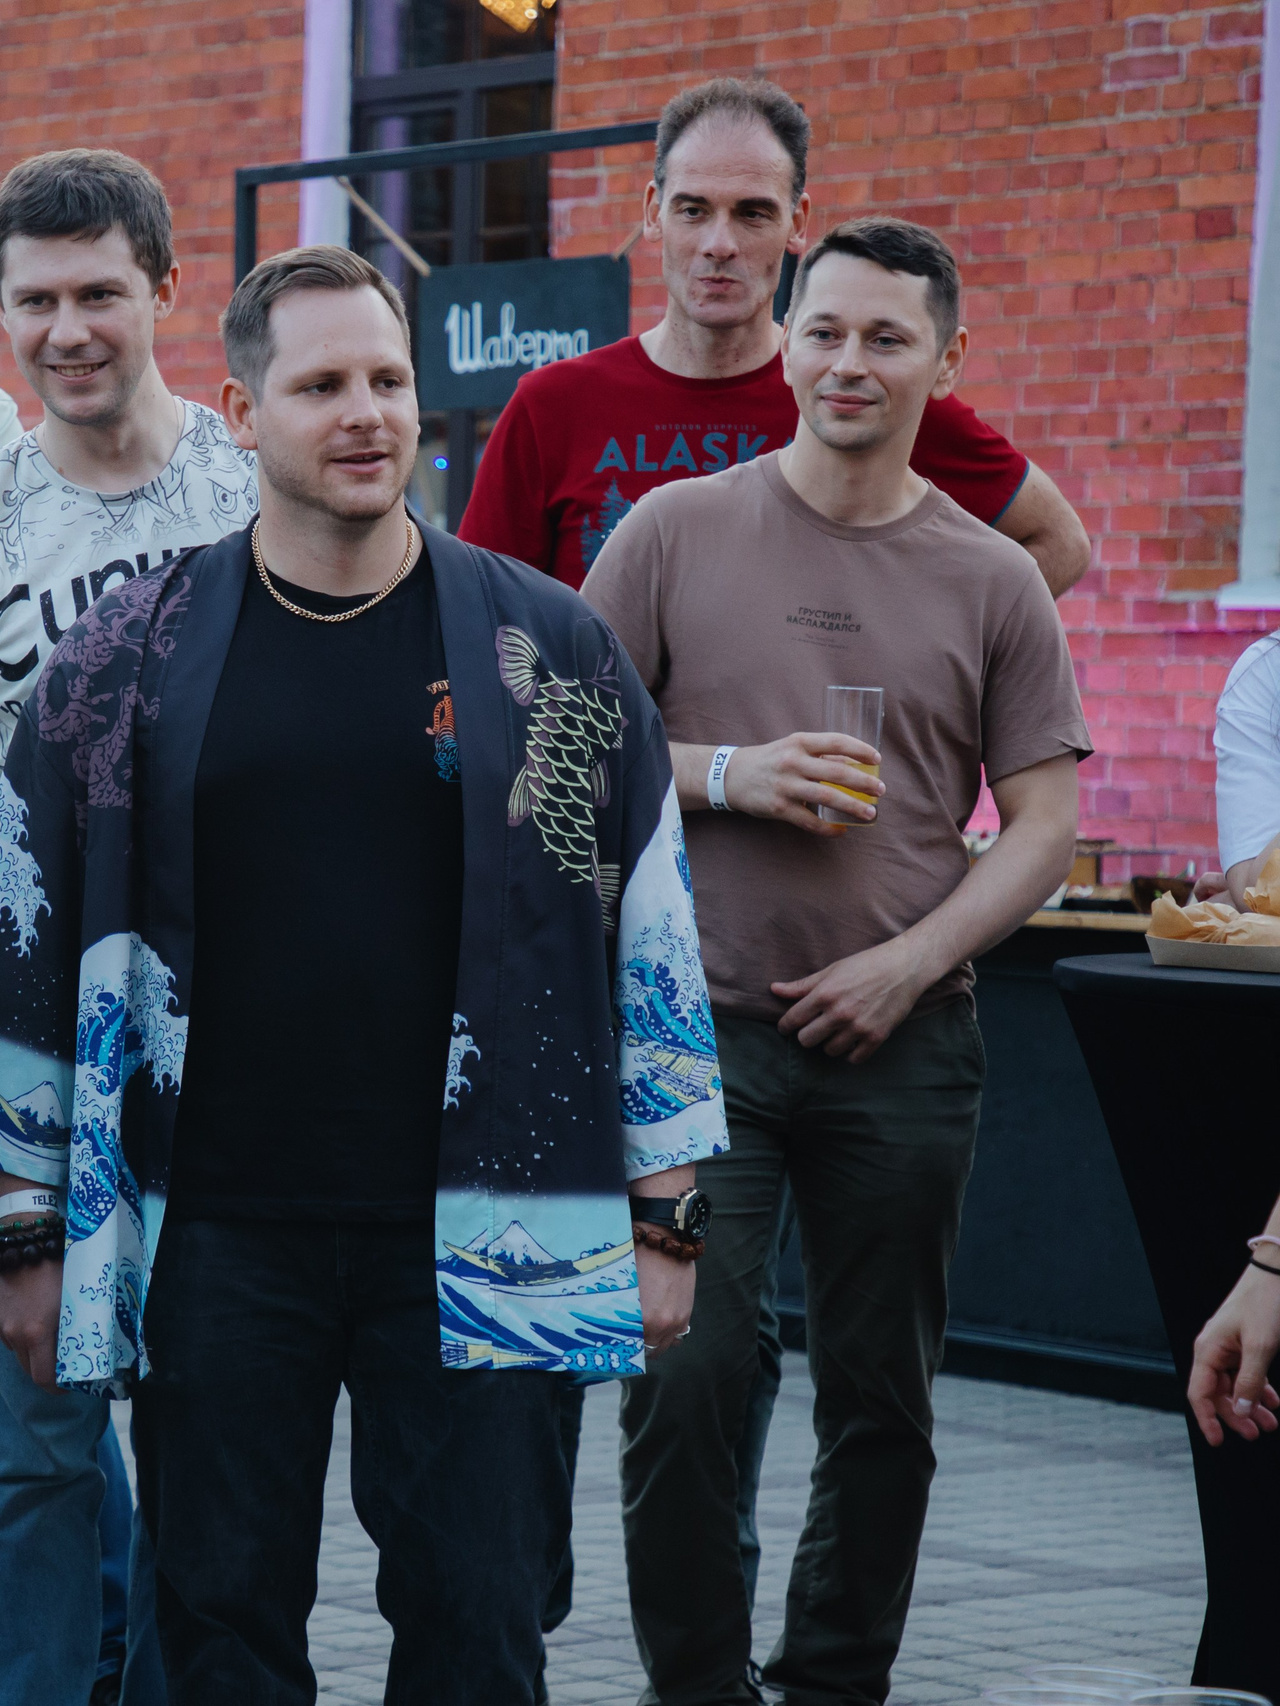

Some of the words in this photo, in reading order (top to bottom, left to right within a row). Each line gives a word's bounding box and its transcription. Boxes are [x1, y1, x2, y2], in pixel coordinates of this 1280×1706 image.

[444, 301, 590, 375] Шаверма
[593, 431, 794, 473] ALASK
[844, 612, 852, 622] И
[713, 752, 728, 781] TELE2
